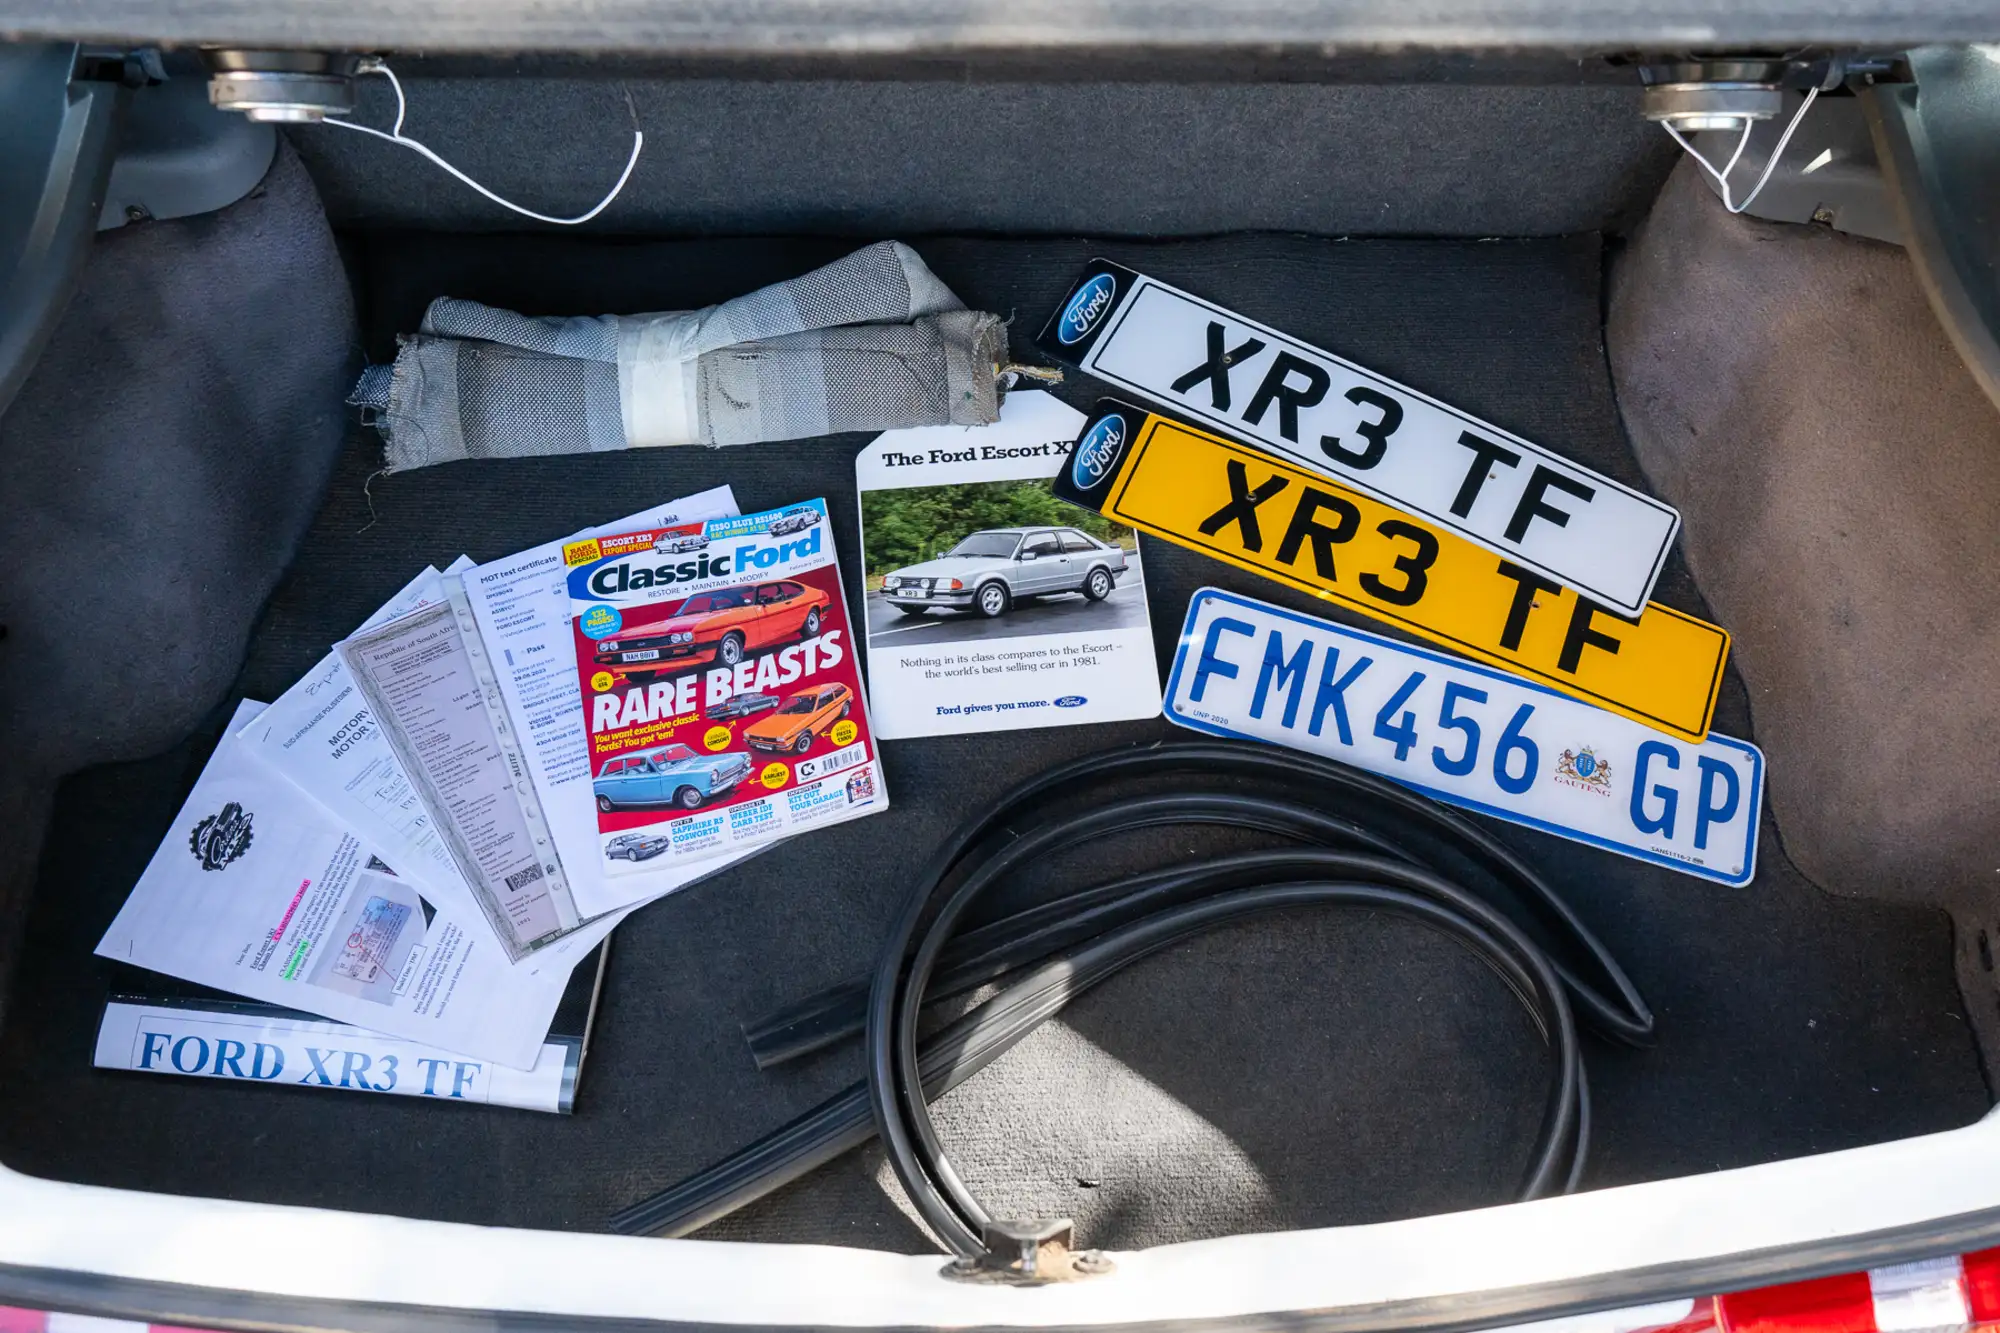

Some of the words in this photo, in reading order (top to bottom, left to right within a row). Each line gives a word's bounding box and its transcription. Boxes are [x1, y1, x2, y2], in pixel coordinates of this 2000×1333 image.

[1075, 285, 1110, 332] Ford
[1170, 321, 1404, 470] XR3
[1449, 430, 1595, 545] TF
[882, 452, 924, 467] The
[929, 448, 975, 464] Ford
[981, 445, 1048, 460] Escort
[1083, 426, 1120, 478] Ford
[710, 522, 732, 531] ESSO
[734, 519, 754, 528] BLUE
[570, 543, 593, 554] RARE
[602, 535, 633, 549] ESCORT
[635, 533, 653, 544] XR3
[602, 544, 626, 556] EXPORT
[627, 541, 653, 552] SPECIAL
[569, 549, 597, 561] FORDS
[479, 572, 500, 584] MOT
[499, 566, 516, 578] test
[516, 553, 558, 572] certificate
[1198, 459, 1439, 606] XR3
[1497, 559, 1642, 675] TF
[648, 586, 680, 598] RESTORE
[691, 579, 729, 591] MAINTAIN
[739, 571, 769, 583] MODIFY
[372, 643, 406, 661] Republic
[406, 639, 415, 648] of
[415, 631, 438, 645] South
[526, 643, 545, 653] Pass
[900, 656, 941, 669] Nothing
[944, 654, 954, 664] in
[957, 653, 969, 663] its
[971, 651, 995, 662] class
[998, 647, 1047, 663] compares
[1050, 646, 1060, 657] to
[1063, 645, 1079, 656] the
[1082, 642, 1113, 654] Escort
[925, 669, 941, 679] the
[944, 665, 980, 676] world's
[982, 664, 1003, 674] best
[1006, 661, 1037, 674] selling
[1040, 660, 1057, 670] car
[1059, 659, 1069, 669] in
[1072, 655, 1100, 667] 1981.
[592, 674, 697, 733] RARE
[706, 629, 843, 707] BEASTS
[936, 705, 961, 715] Ford
[964, 703, 994, 715] gives
[996, 703, 1016, 712] you
[1018, 699, 1050, 710] more.
[595, 733, 612, 744] You
[614, 729, 640, 741] want
[641, 722, 672, 736] exclusive
[672, 713, 700, 730] classic
[1211, 714, 1229, 726] 2020
[330, 723, 370, 760] MOTOR
[596, 740, 623, 753] Fords?
[625, 736, 641, 747] You
[642, 733, 655, 747] got
[656, 728, 674, 743] 'em!
[788, 792, 804, 805] KIT
[804, 789, 821, 801] OUT
[1554, 775, 1612, 798] GAUTENG
[1630, 740, 1740, 850] GP
[789, 798, 812, 812] YOUR
[813, 789, 844, 806] GARAGE
[730, 807, 757, 821] WEBER
[755, 811, 774, 824] TEST
[671, 820, 709, 836] SAPPHIRE
[711, 817, 724, 827] RS
[672, 827, 720, 843] COSWORTH
[138, 1032, 285, 1080] FORD
[297, 1046, 398, 1092] XR3
[417, 1058, 482, 1099] TF
